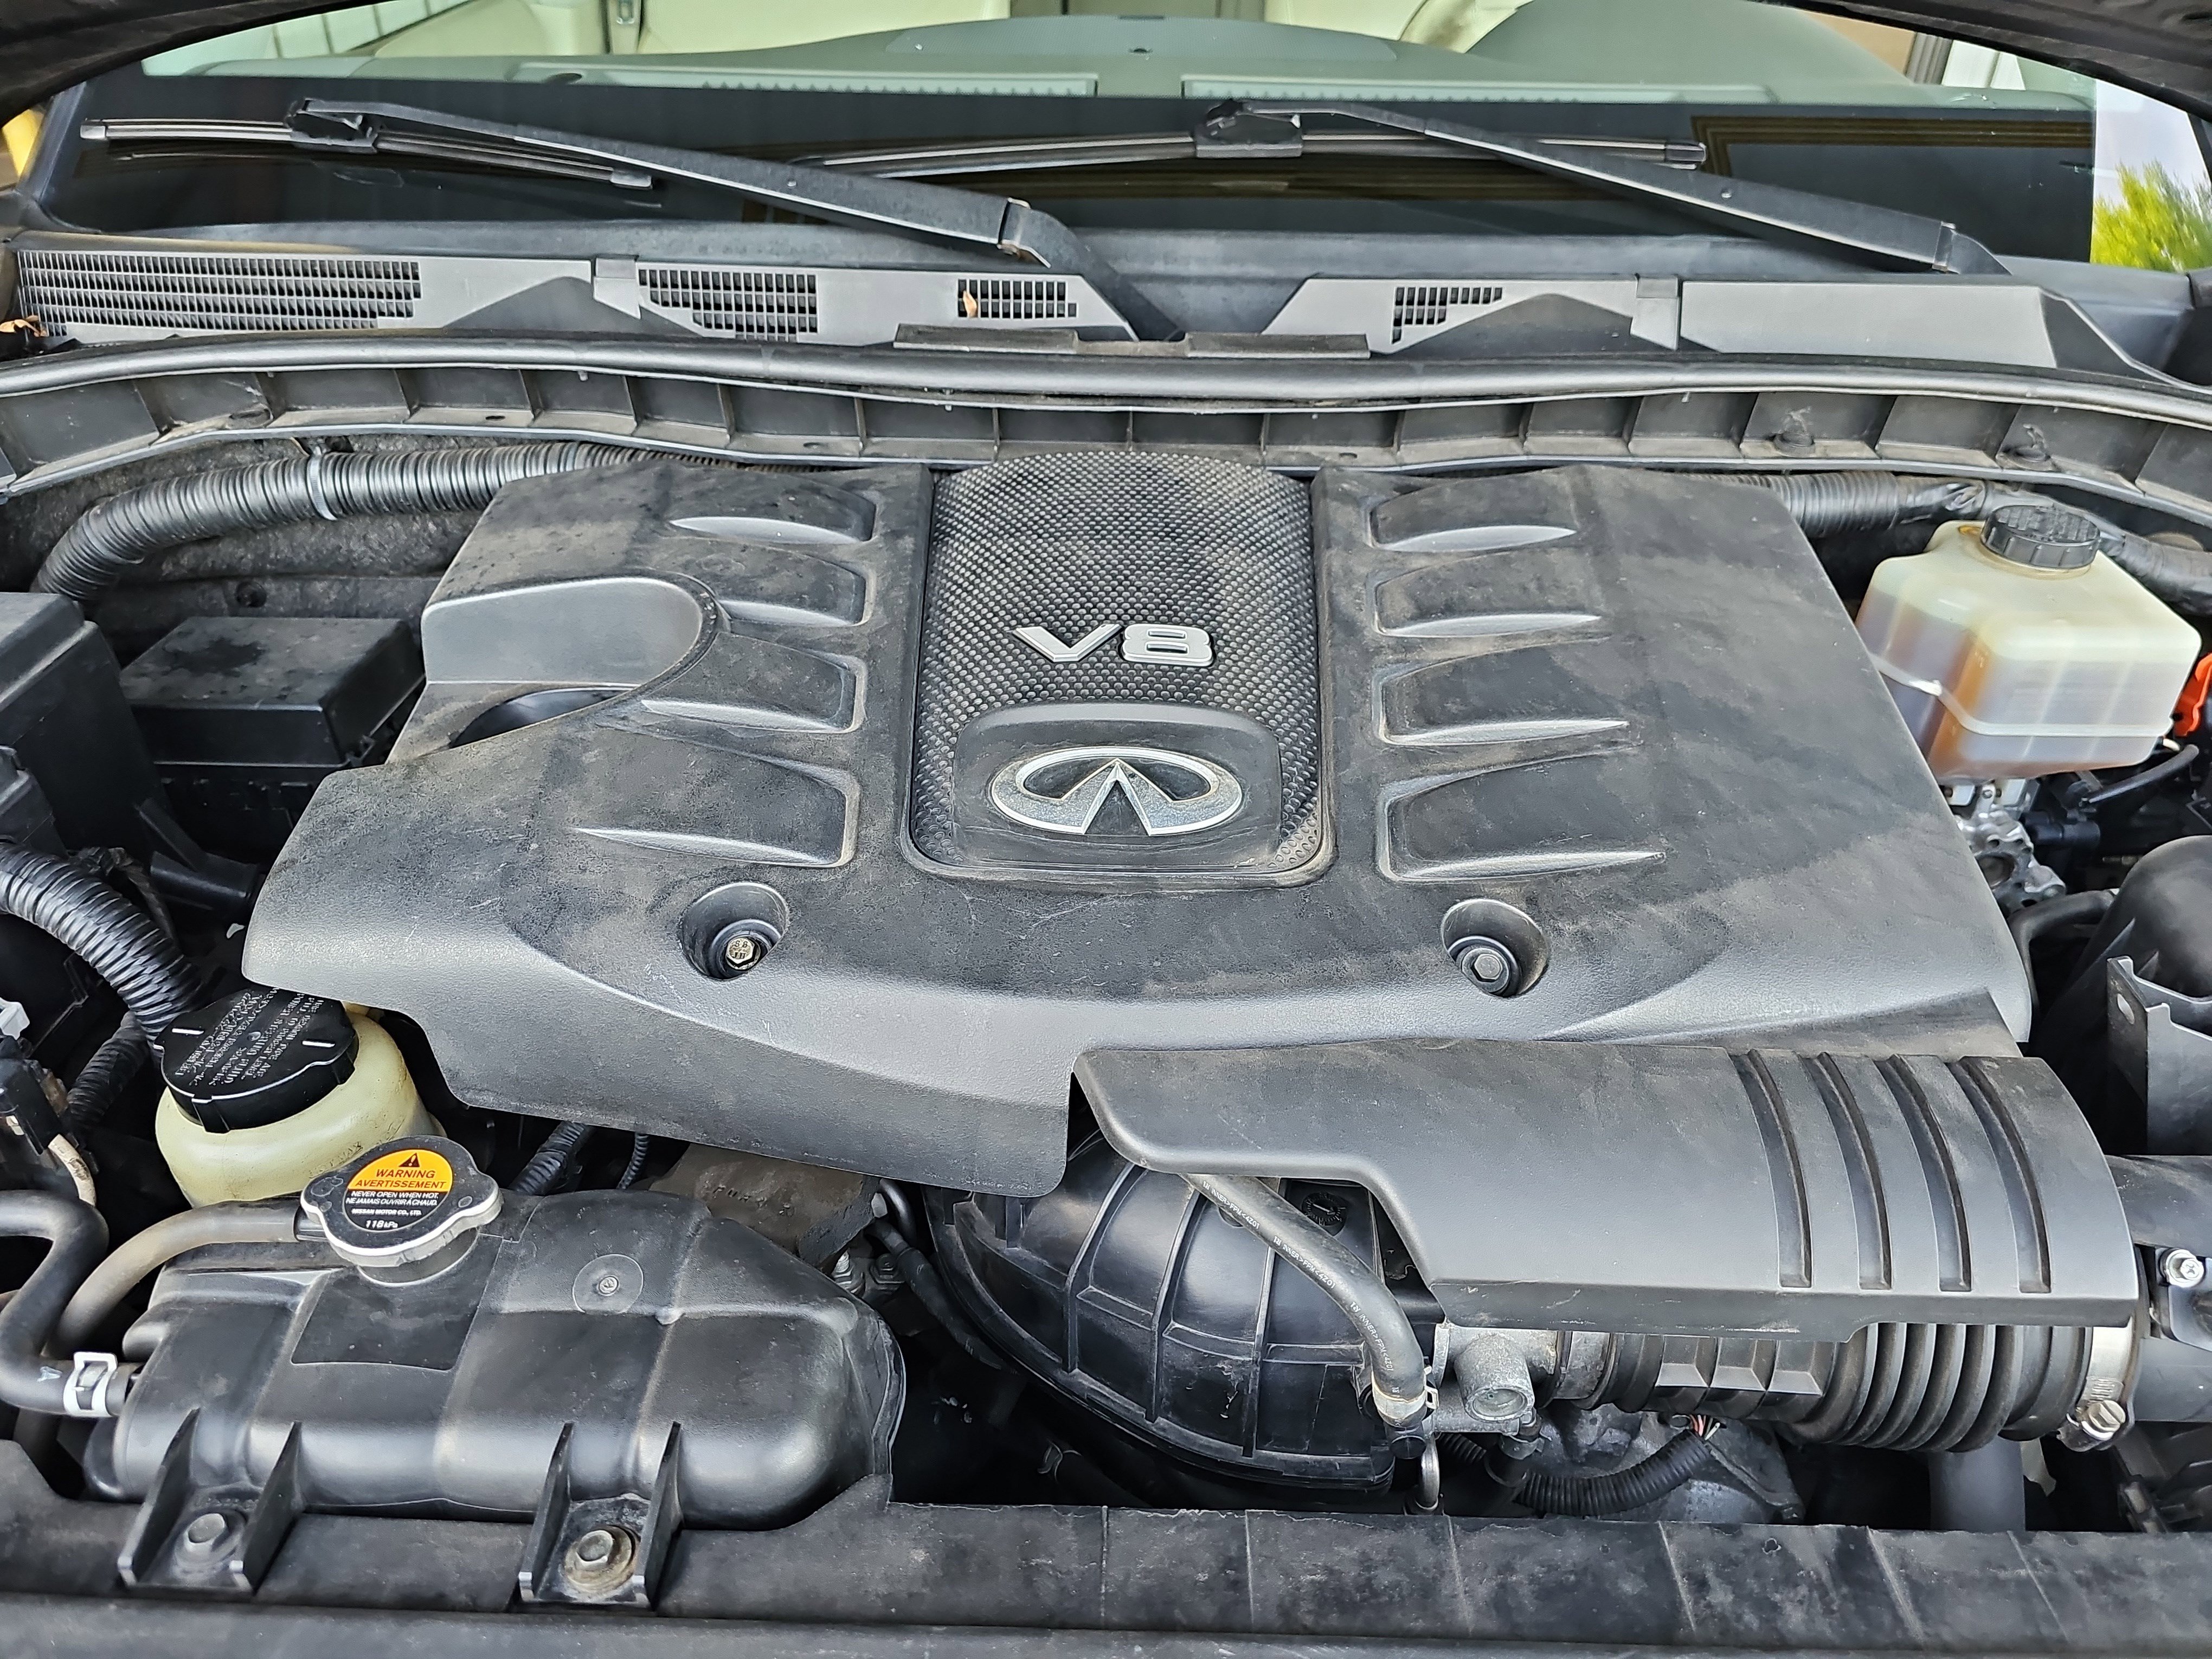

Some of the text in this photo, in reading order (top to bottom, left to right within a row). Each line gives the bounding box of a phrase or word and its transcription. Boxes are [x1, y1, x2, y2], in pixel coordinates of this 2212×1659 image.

[1012, 623, 1212, 666] V8
[376, 1169, 435, 1179] WARNING
[355, 1180, 447, 1189] AVERTISSEMENT
